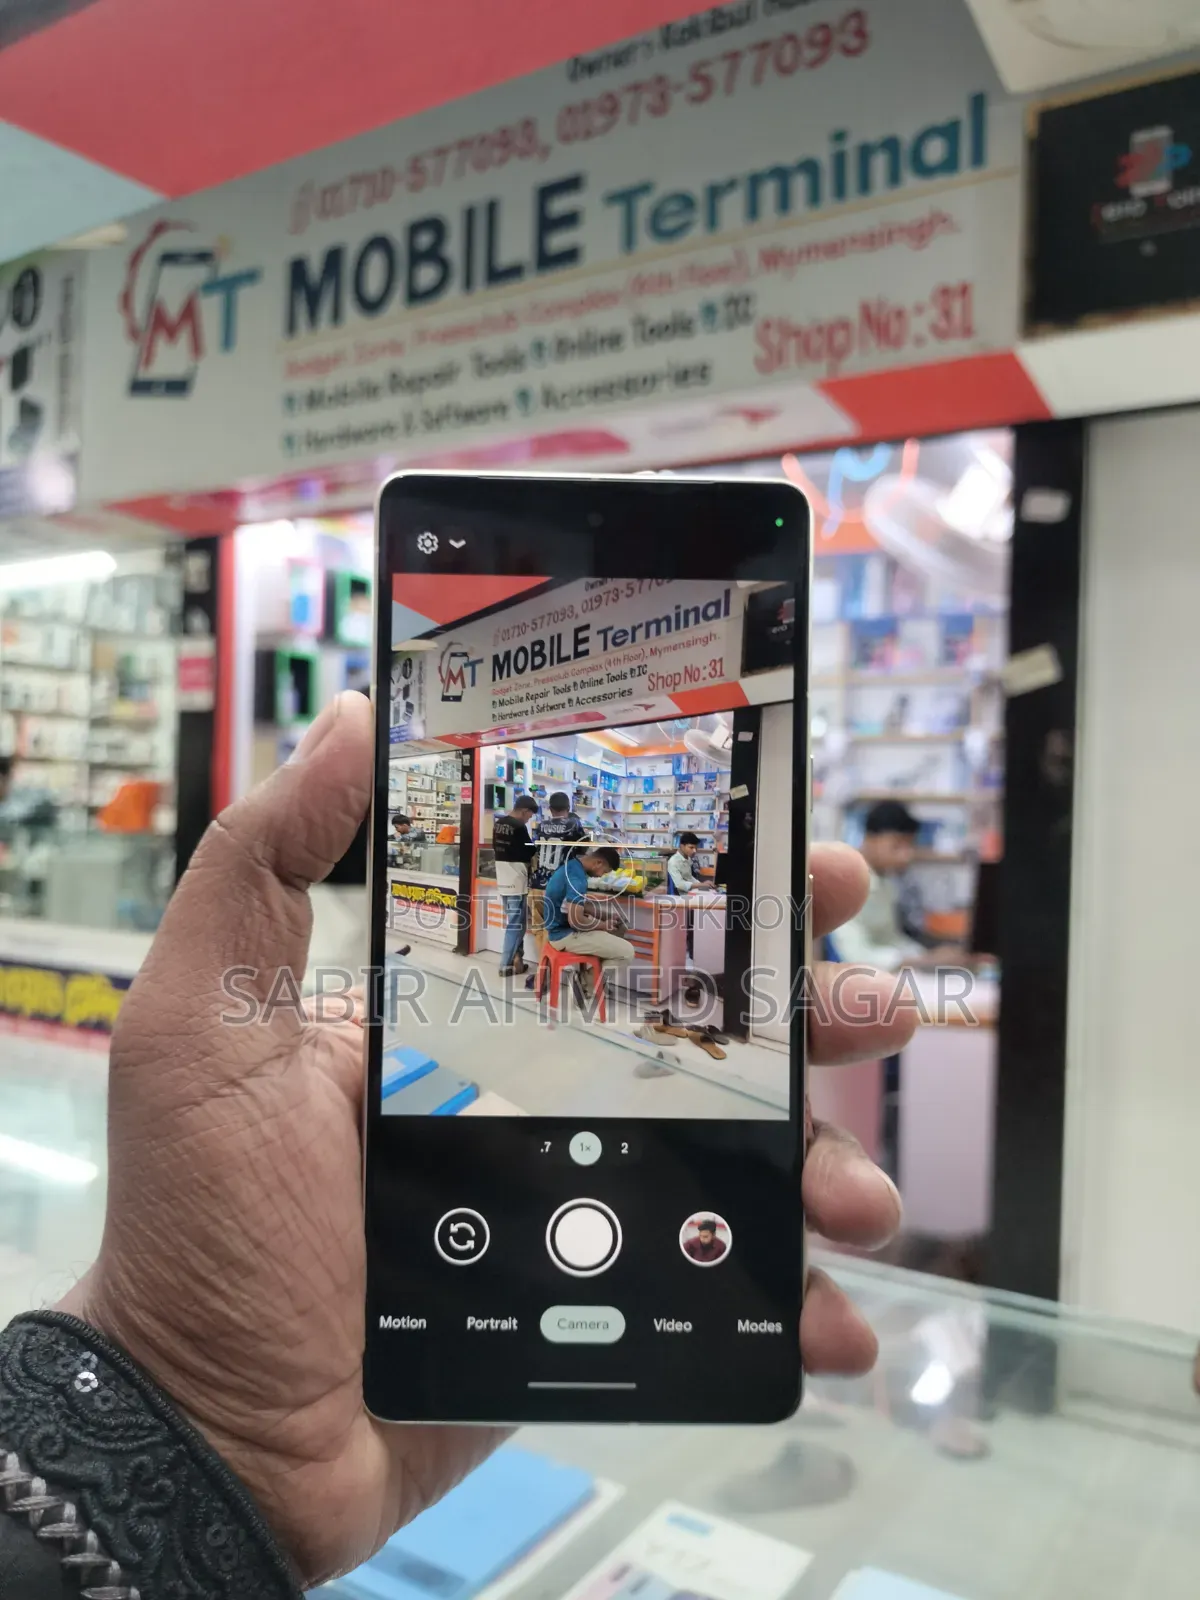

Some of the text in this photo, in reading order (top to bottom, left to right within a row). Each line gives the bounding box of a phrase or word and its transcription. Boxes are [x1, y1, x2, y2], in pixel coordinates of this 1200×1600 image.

[286, 90, 988, 338] MOBILE Terminal
[752, 308, 853, 376] Shop
[491, 588, 731, 682] MOBILE Terminal
[498, 695, 524, 707] Mobile
[525, 688, 550, 704] Repair
[552, 683, 572, 696] Tools
[579, 677, 604, 690] Online
[606, 669, 628, 684] Tools
[647, 671, 682, 692] Shop
[535, 701, 566, 714] Software
[575, 687, 633, 706] Accessories
[621, 1142, 629, 1154] 2
[379, 1315, 427, 1329] Motion
[466, 1316, 518, 1330] Portrait
[556, 1317, 610, 1331] Camera
[653, 1318, 693, 1332] Video
[737, 1319, 783, 1333] Modes
